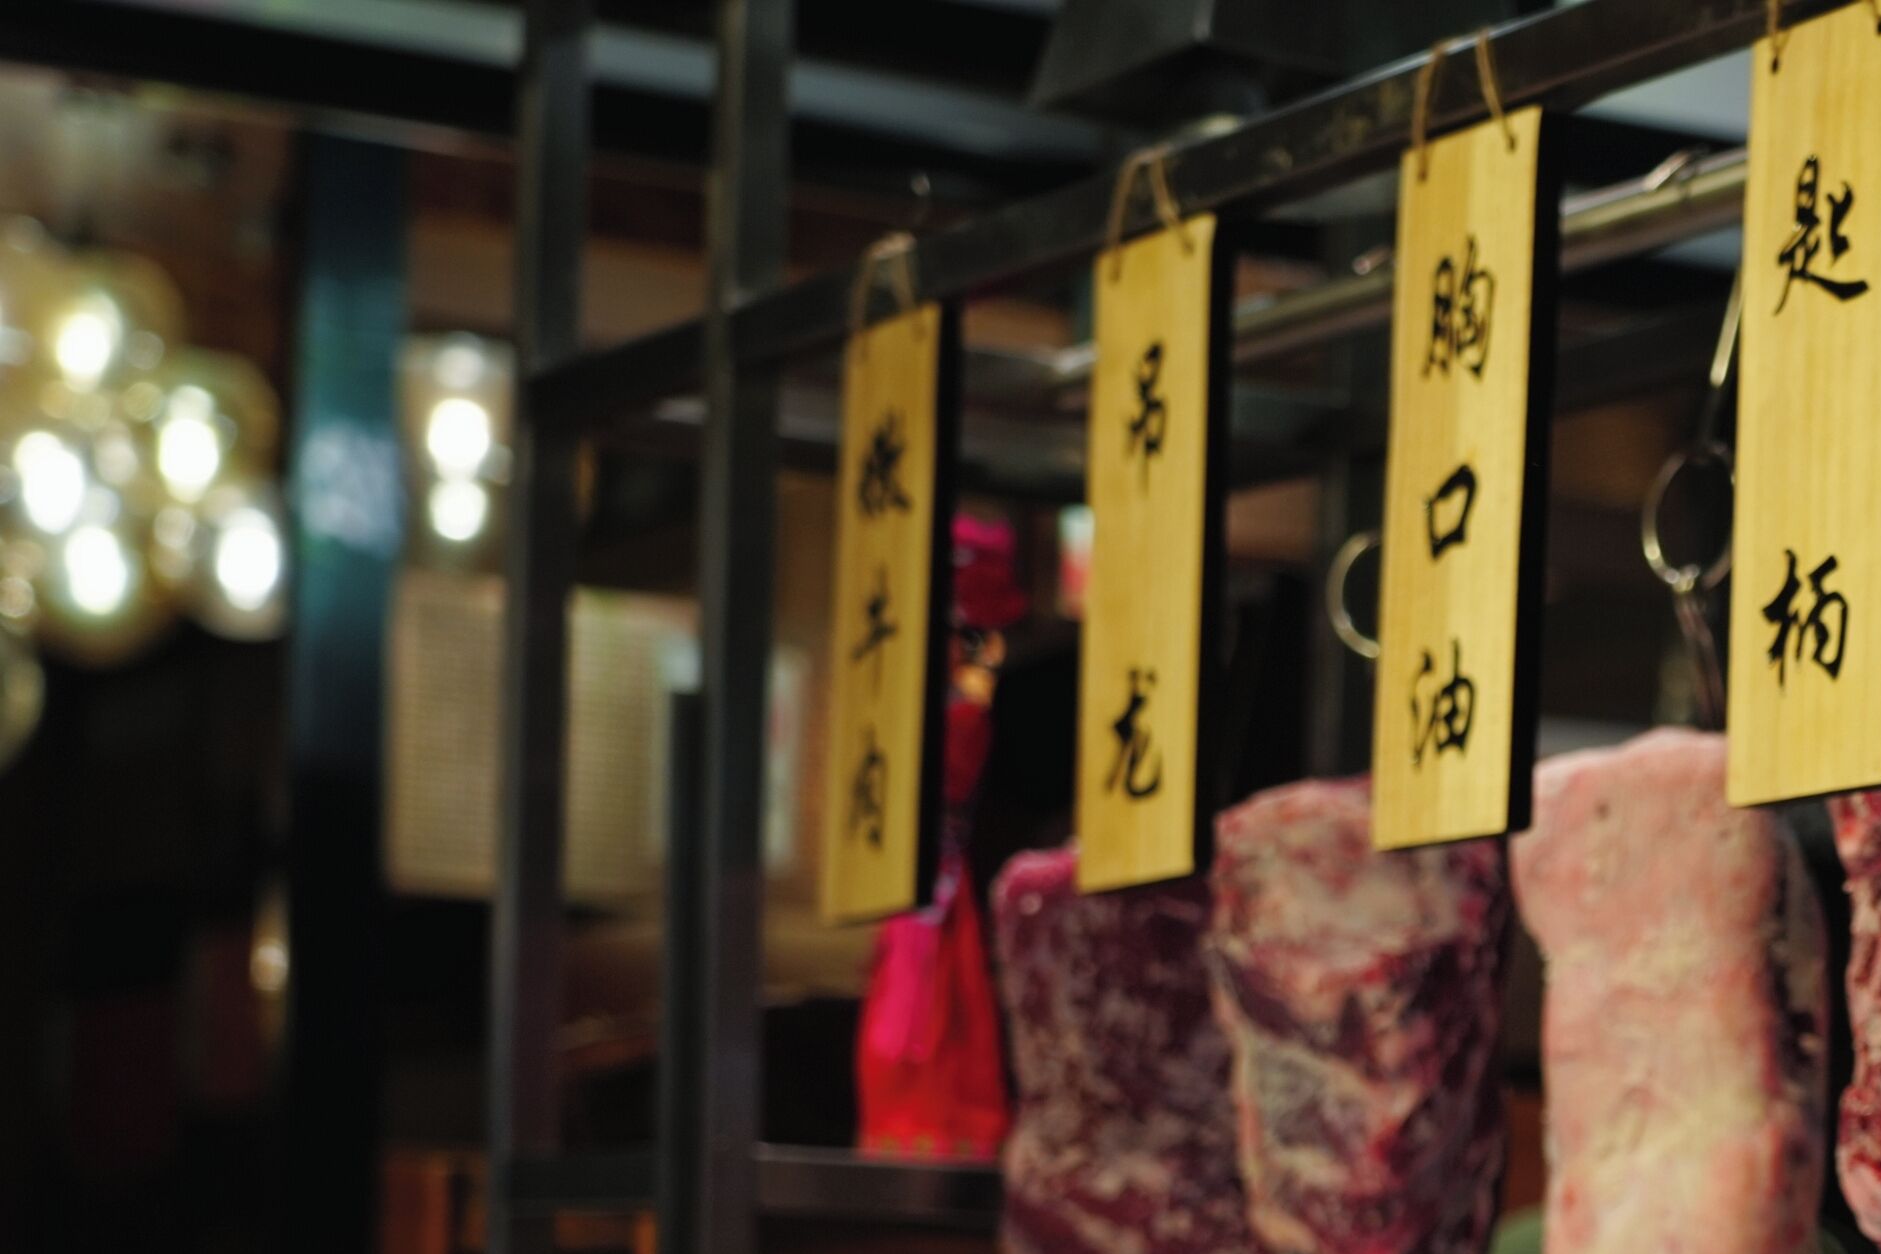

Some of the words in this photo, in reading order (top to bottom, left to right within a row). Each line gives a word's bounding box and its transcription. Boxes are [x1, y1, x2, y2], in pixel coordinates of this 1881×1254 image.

[1411, 234, 1497, 770] 胸口油
[1761, 153, 1870, 690] 匙柄
